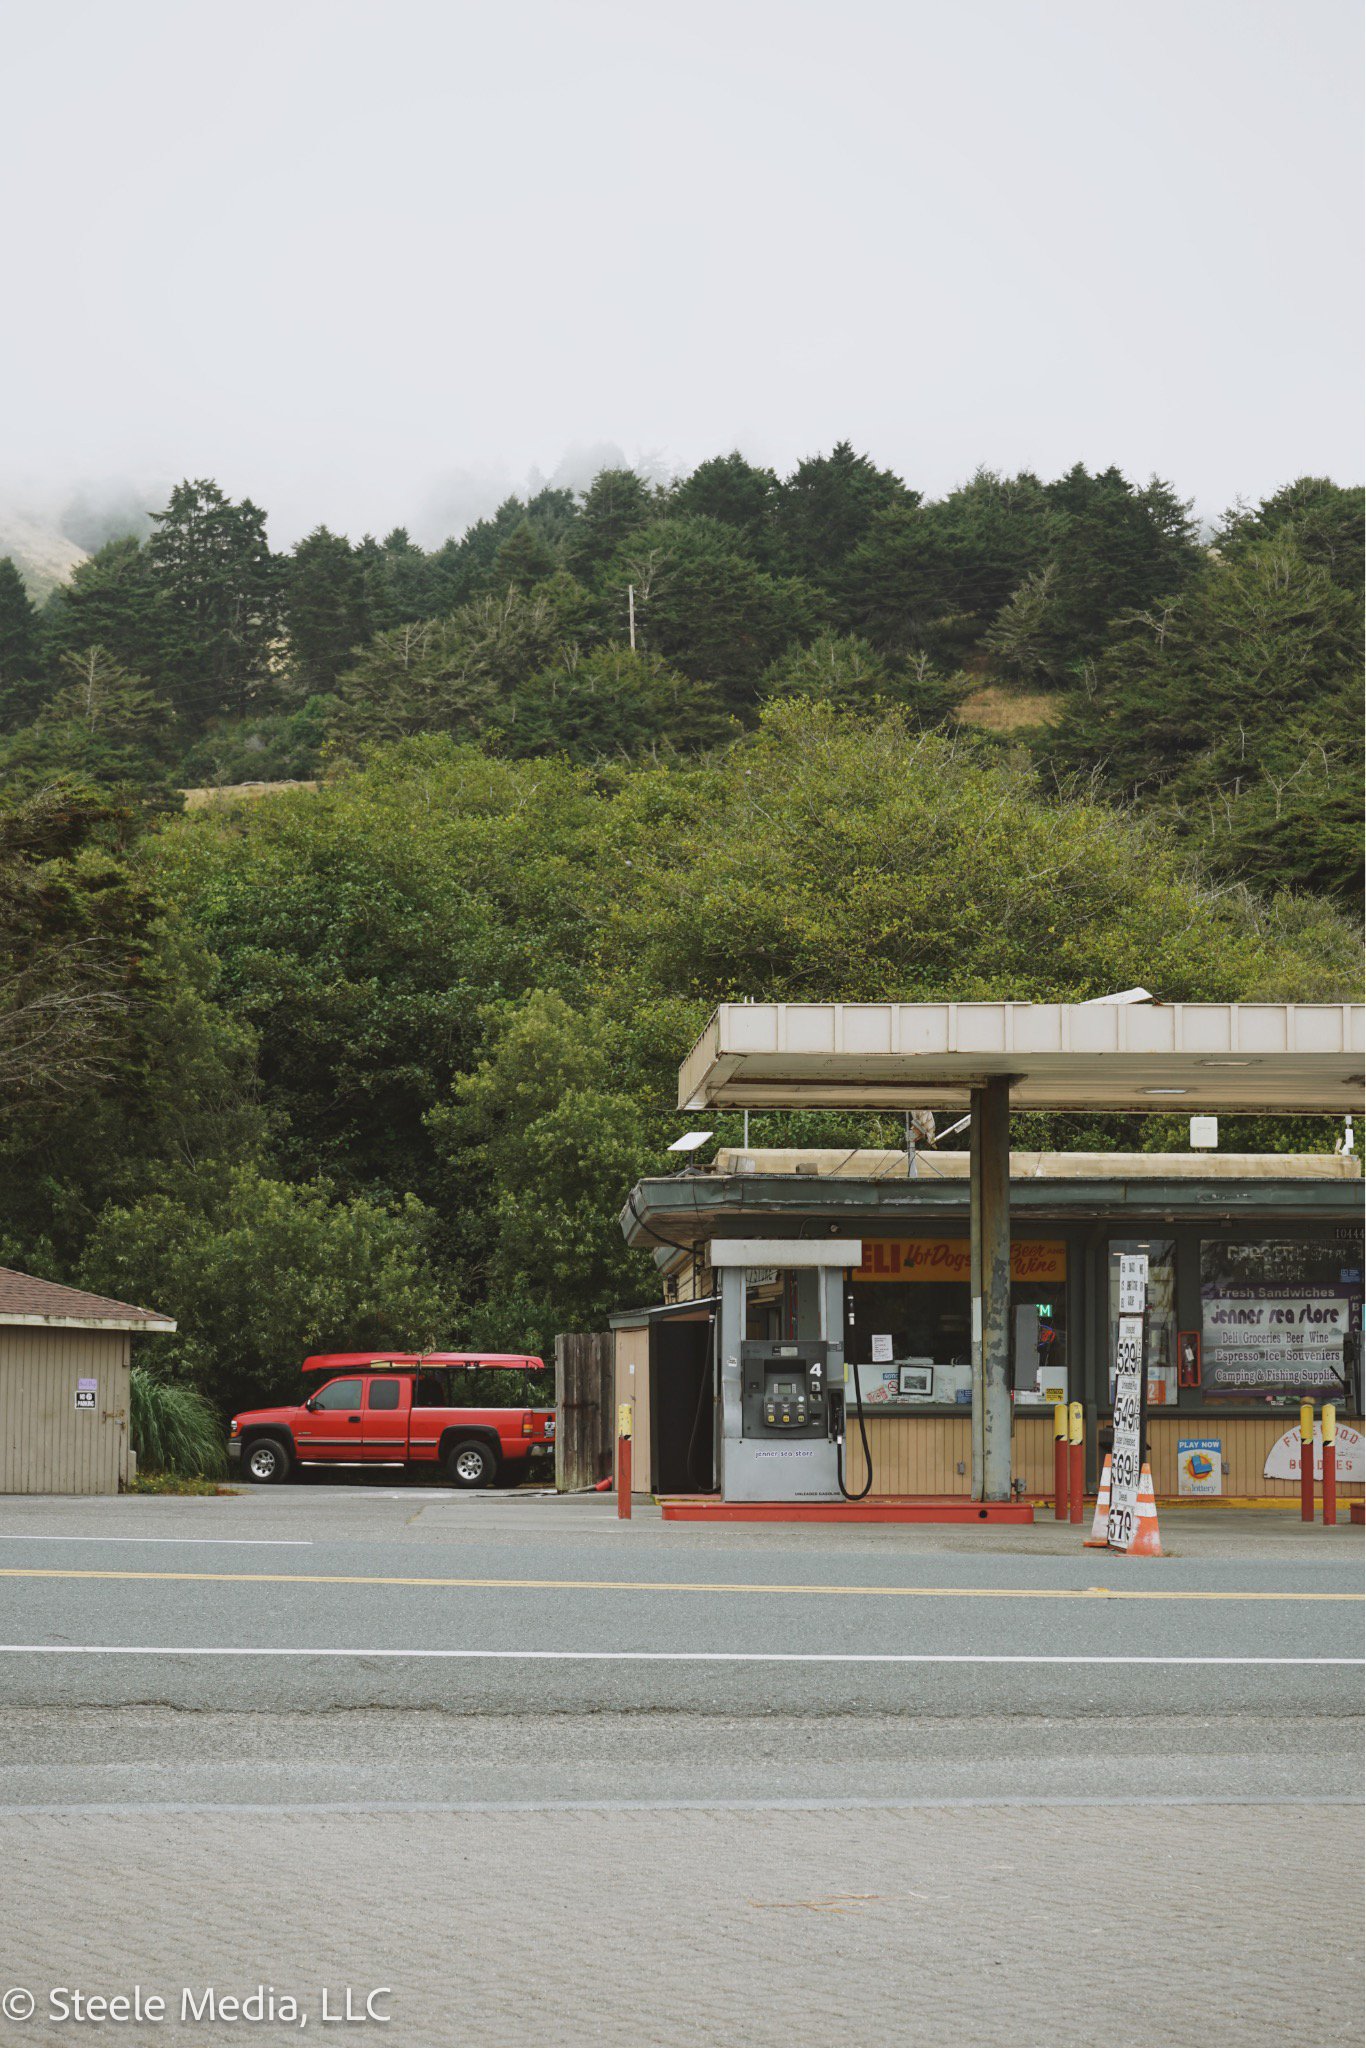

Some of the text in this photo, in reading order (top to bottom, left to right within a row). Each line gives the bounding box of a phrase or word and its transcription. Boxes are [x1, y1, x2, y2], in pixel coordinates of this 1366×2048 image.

[857, 1244, 899, 1273] ELI
[1014, 1257, 1057, 1275] Wine
[1219, 1287, 1335, 1298] Fresh Sandwiches
[1211, 1303, 1340, 1324] jenner sea store
[1222, 1331, 1329, 1344] Deli Groceries Beer Wine
[1215, 1350, 1340, 1365] Espresso Ice Souveniers
[809, 1363, 822, 1377] 4
[1216, 1369, 1339, 1384] Camping & Fishing Supplies
[1179, 1441, 1198, 1449] PLAY
